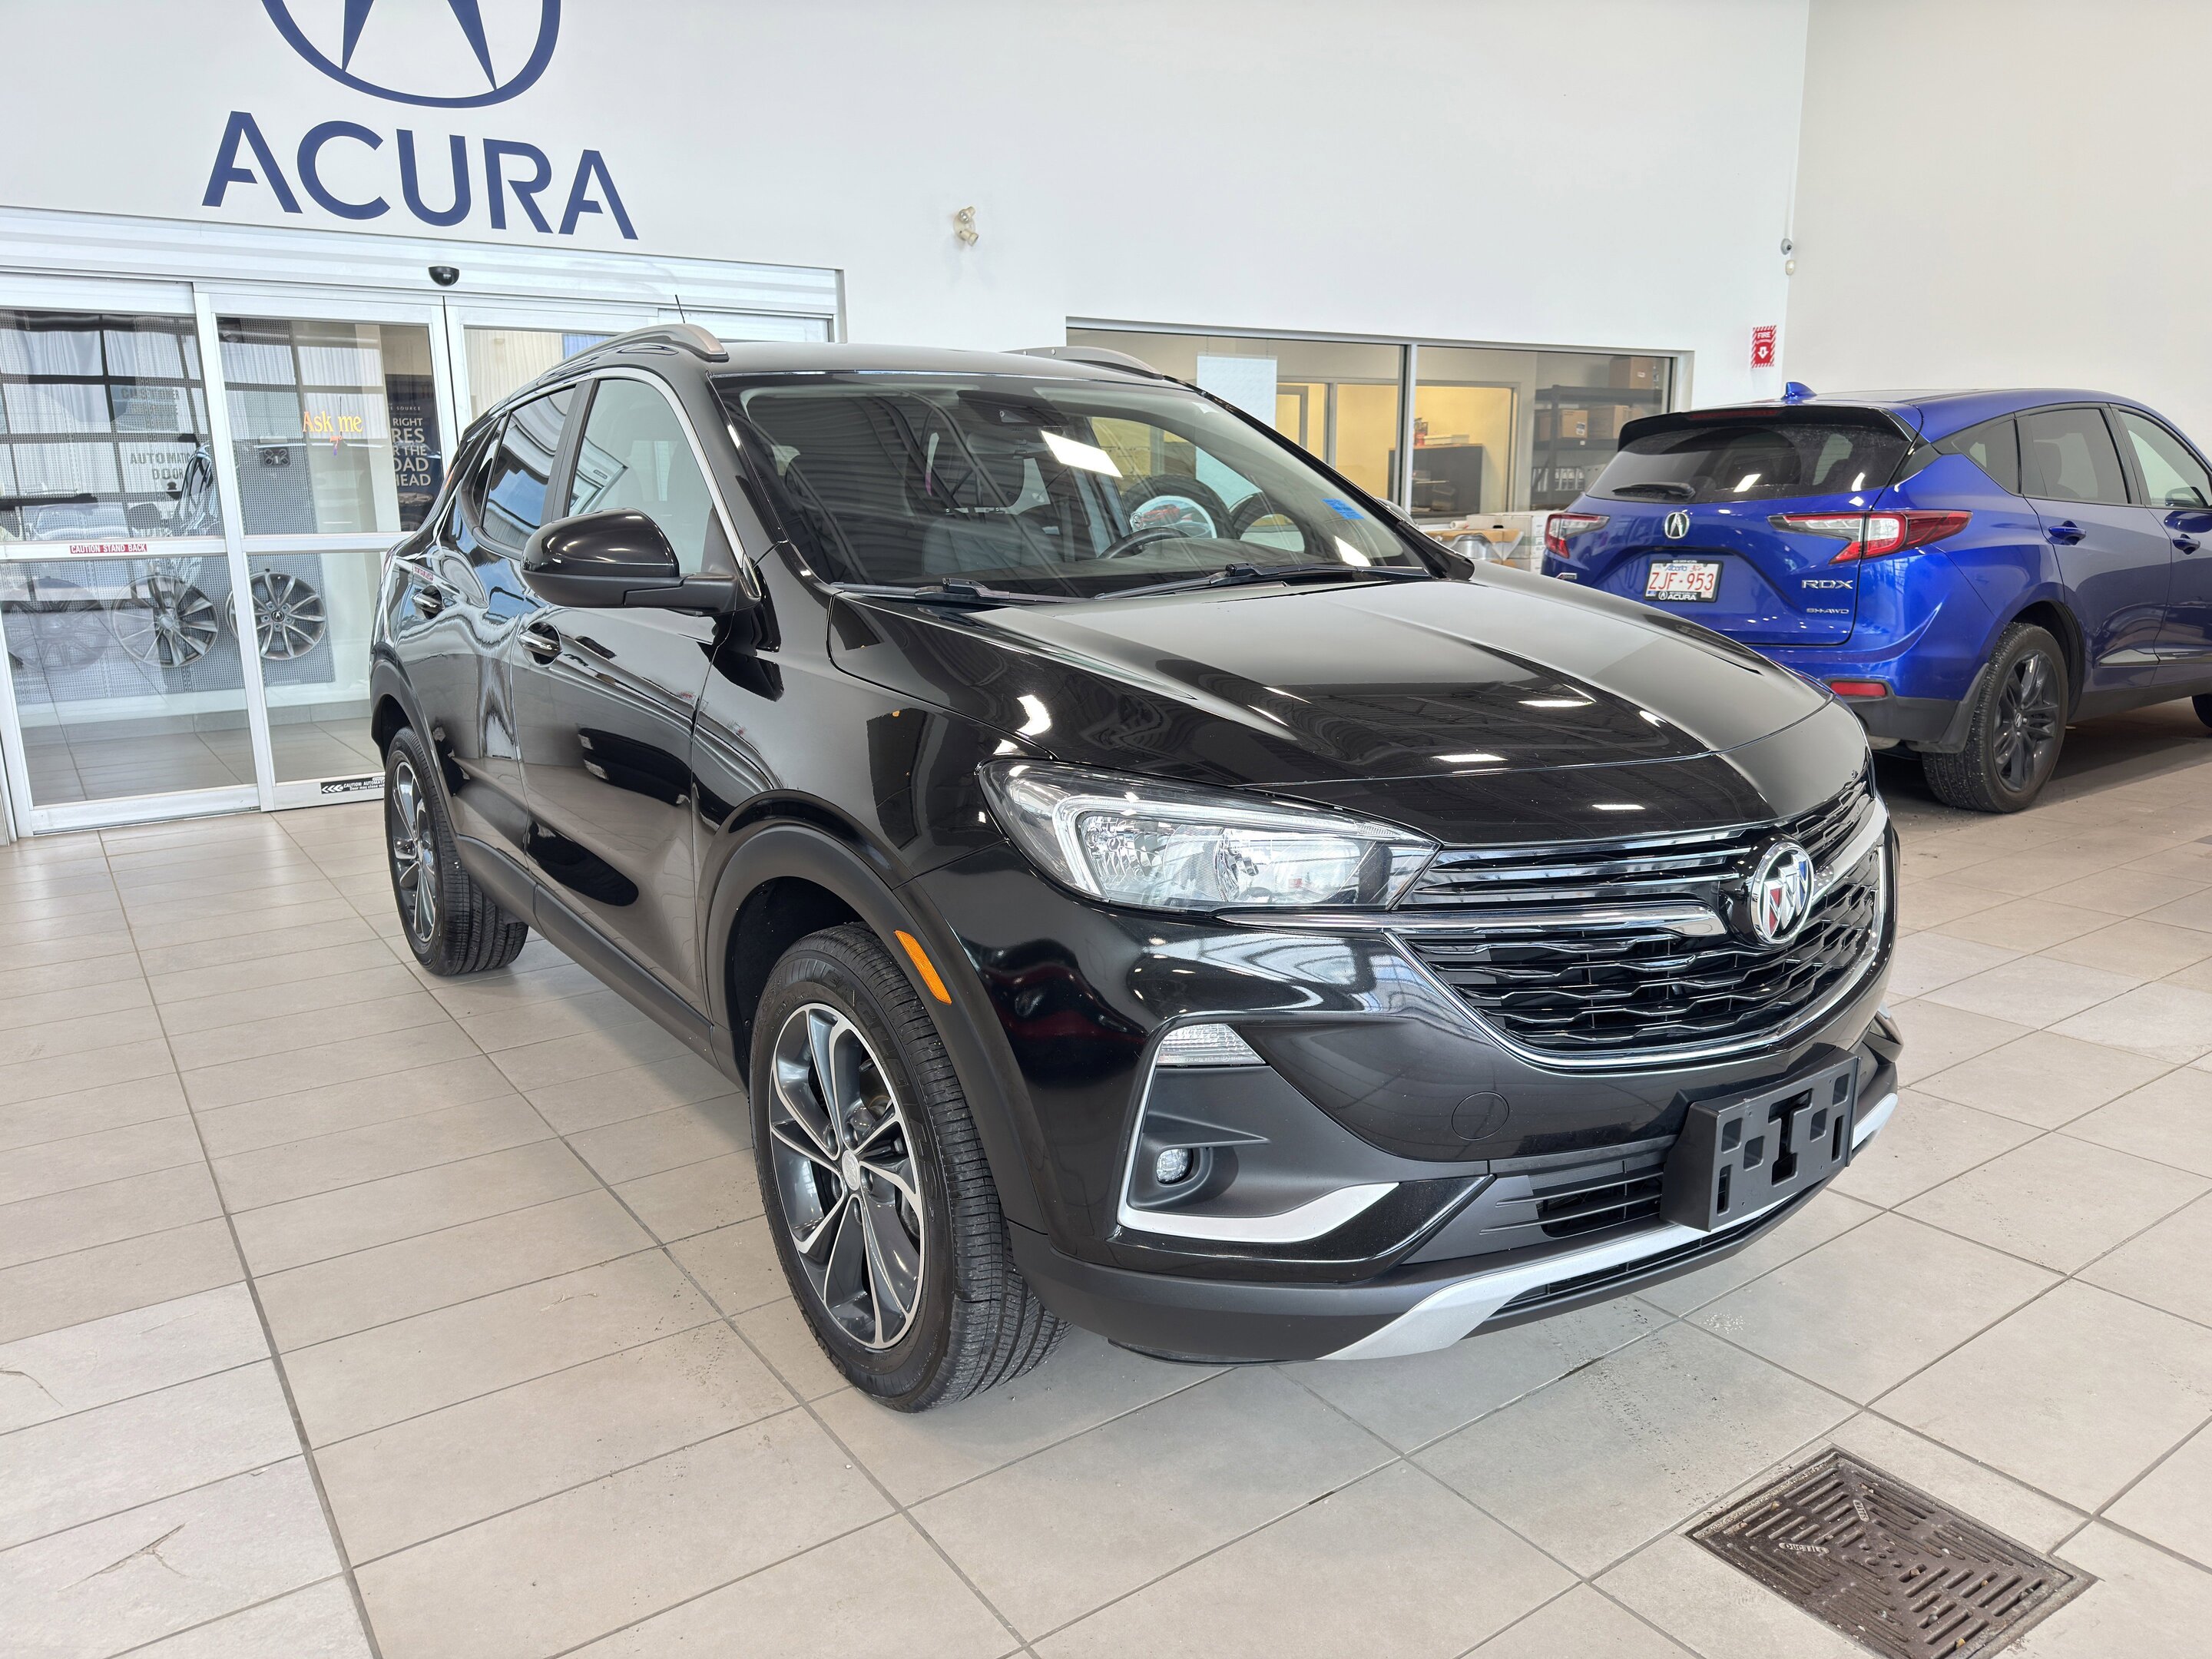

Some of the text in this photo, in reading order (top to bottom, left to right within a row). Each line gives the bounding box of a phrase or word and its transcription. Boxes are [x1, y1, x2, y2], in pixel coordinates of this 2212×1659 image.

[202, 111, 638, 240] ACURA
[303, 410, 363, 432] Ask me
[392, 417, 423, 426] RIGHT
[391, 428, 425, 443] RES
[404, 445, 427, 455] THE
[393, 457, 429, 472] OAD
[71, 543, 147, 554] CAUTION STAND BACK
[1801, 579, 1853, 589] RDX
